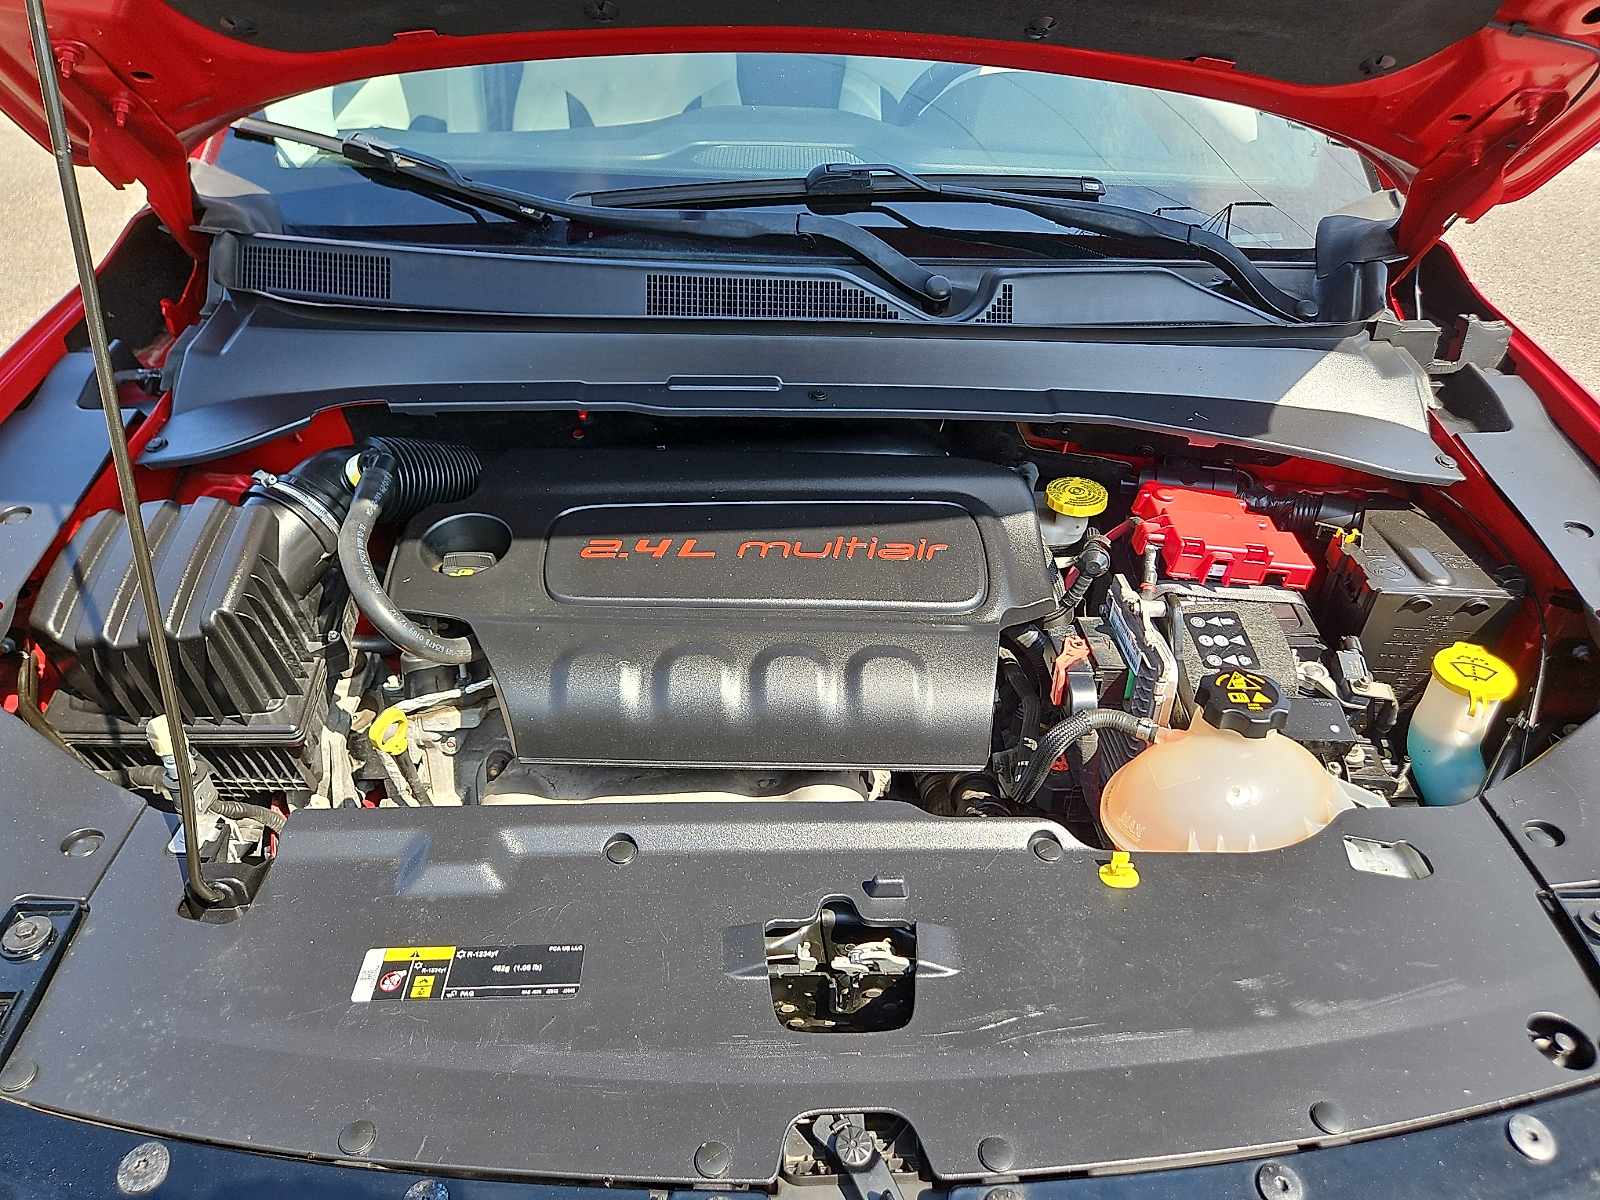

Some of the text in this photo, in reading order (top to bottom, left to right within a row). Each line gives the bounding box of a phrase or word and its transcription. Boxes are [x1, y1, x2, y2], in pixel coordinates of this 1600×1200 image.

[580, 535, 949, 562] 2.4L multiair
[408, 626, 424, 641] 0189
[1118, 810, 1146, 838] MAX
[460, 990, 475, 998] PAG
